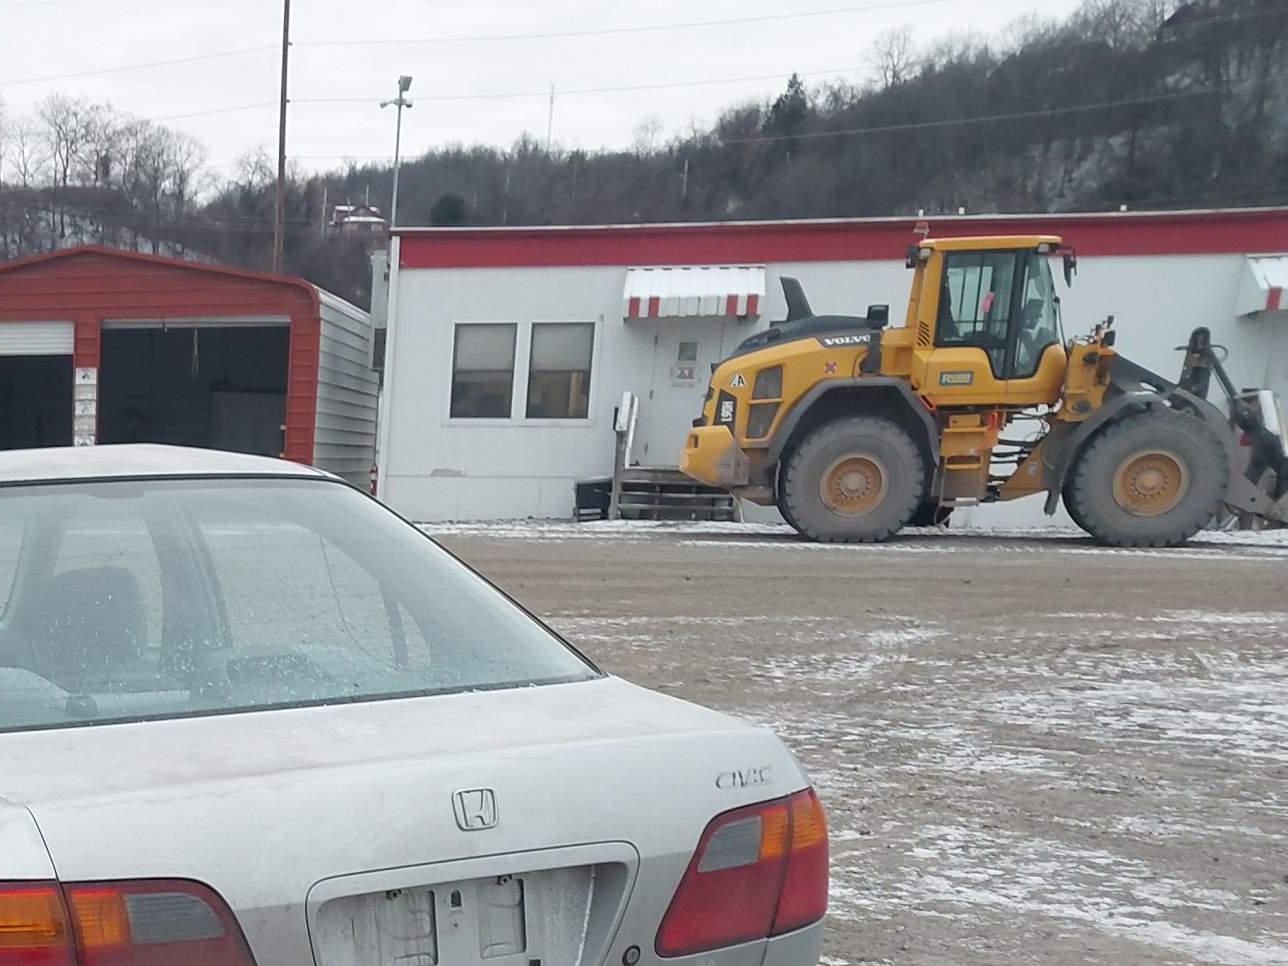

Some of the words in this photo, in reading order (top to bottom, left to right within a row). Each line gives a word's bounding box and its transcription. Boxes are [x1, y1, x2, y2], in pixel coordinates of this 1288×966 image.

[824, 334, 871, 346] VOLVO
[720, 400, 734, 422] L90H
[715, 766, 773, 789] CIVIC
